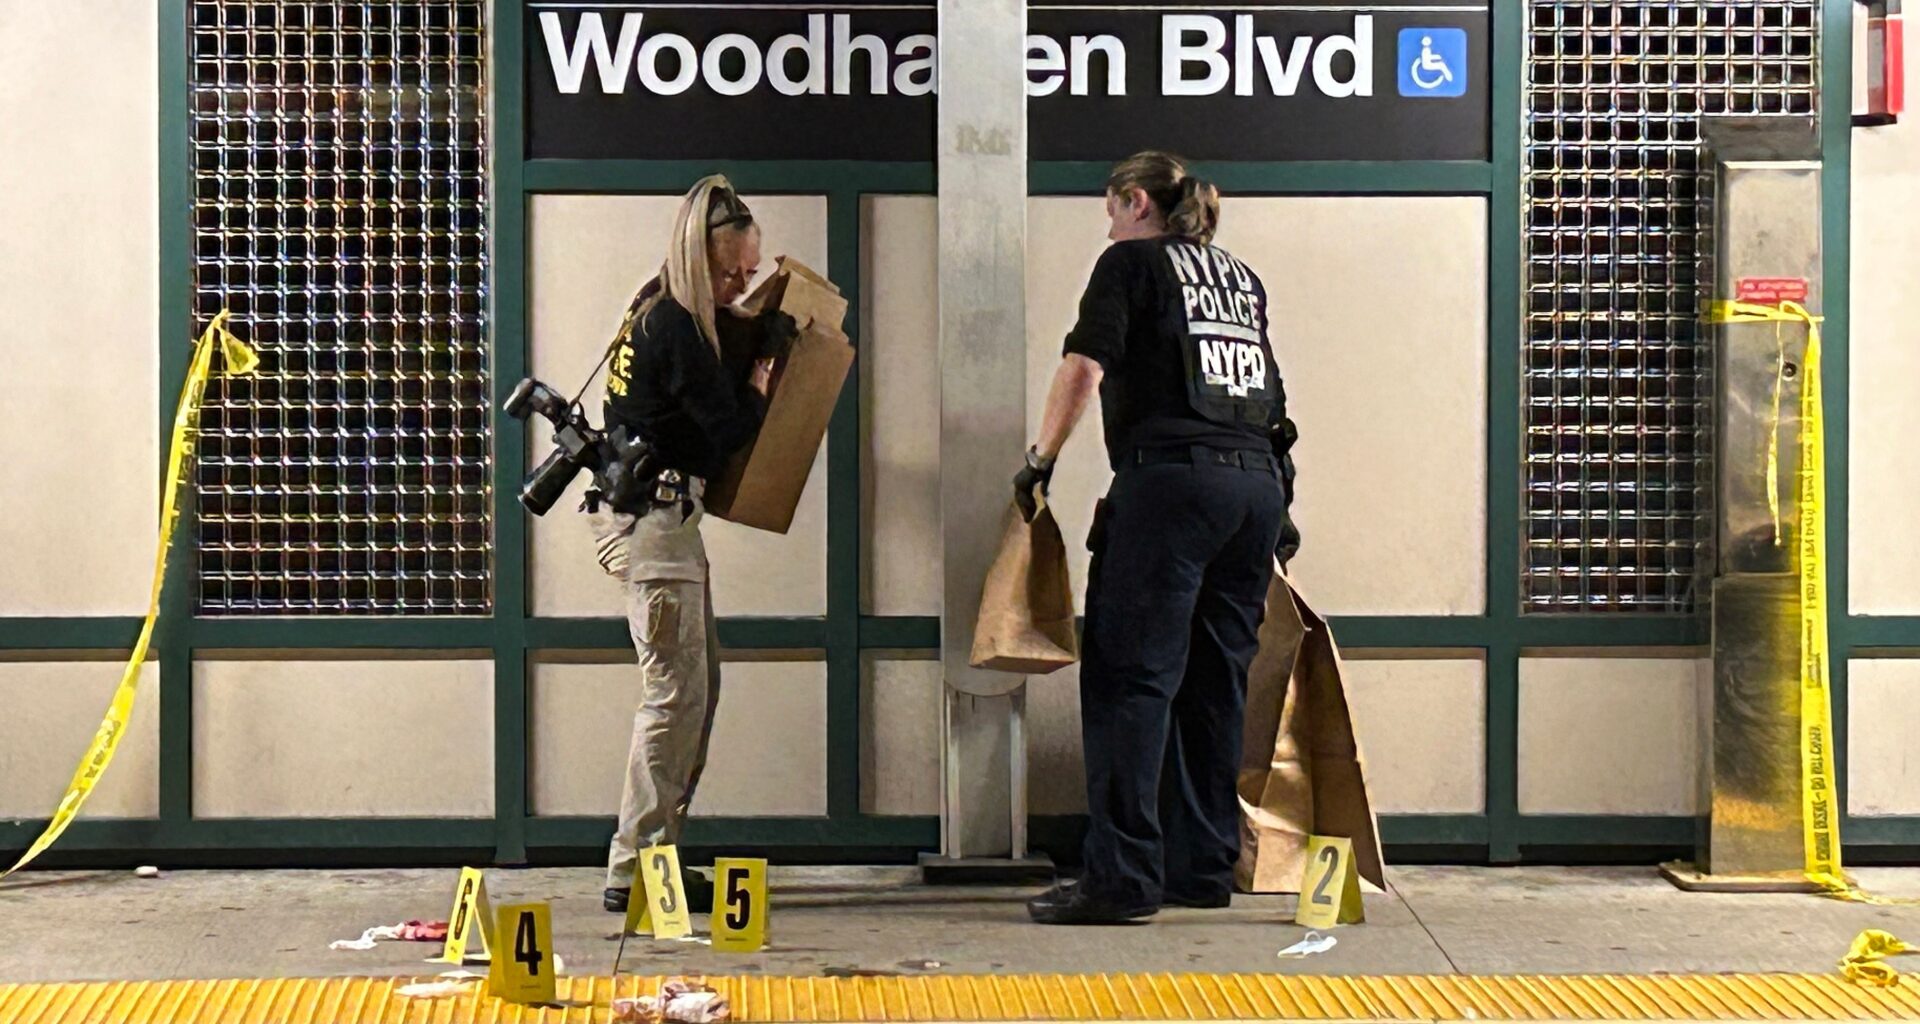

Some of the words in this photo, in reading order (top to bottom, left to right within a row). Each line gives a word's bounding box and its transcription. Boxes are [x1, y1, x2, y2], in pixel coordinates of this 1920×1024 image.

[539, 11, 1127, 96] Woodhaen
[1161, 14, 1374, 97] Blvd
[1165, 243, 1253, 292] NYPD
[1182, 285, 1261, 330] POLICE
[1199, 339, 1266, 388] NYPD
[652, 853, 676, 913] 3
[725, 868, 750, 930] 5
[1311, 845, 1339, 905] 2
[454, 878, 473, 940] 6
[515, 911, 542, 976] 4
